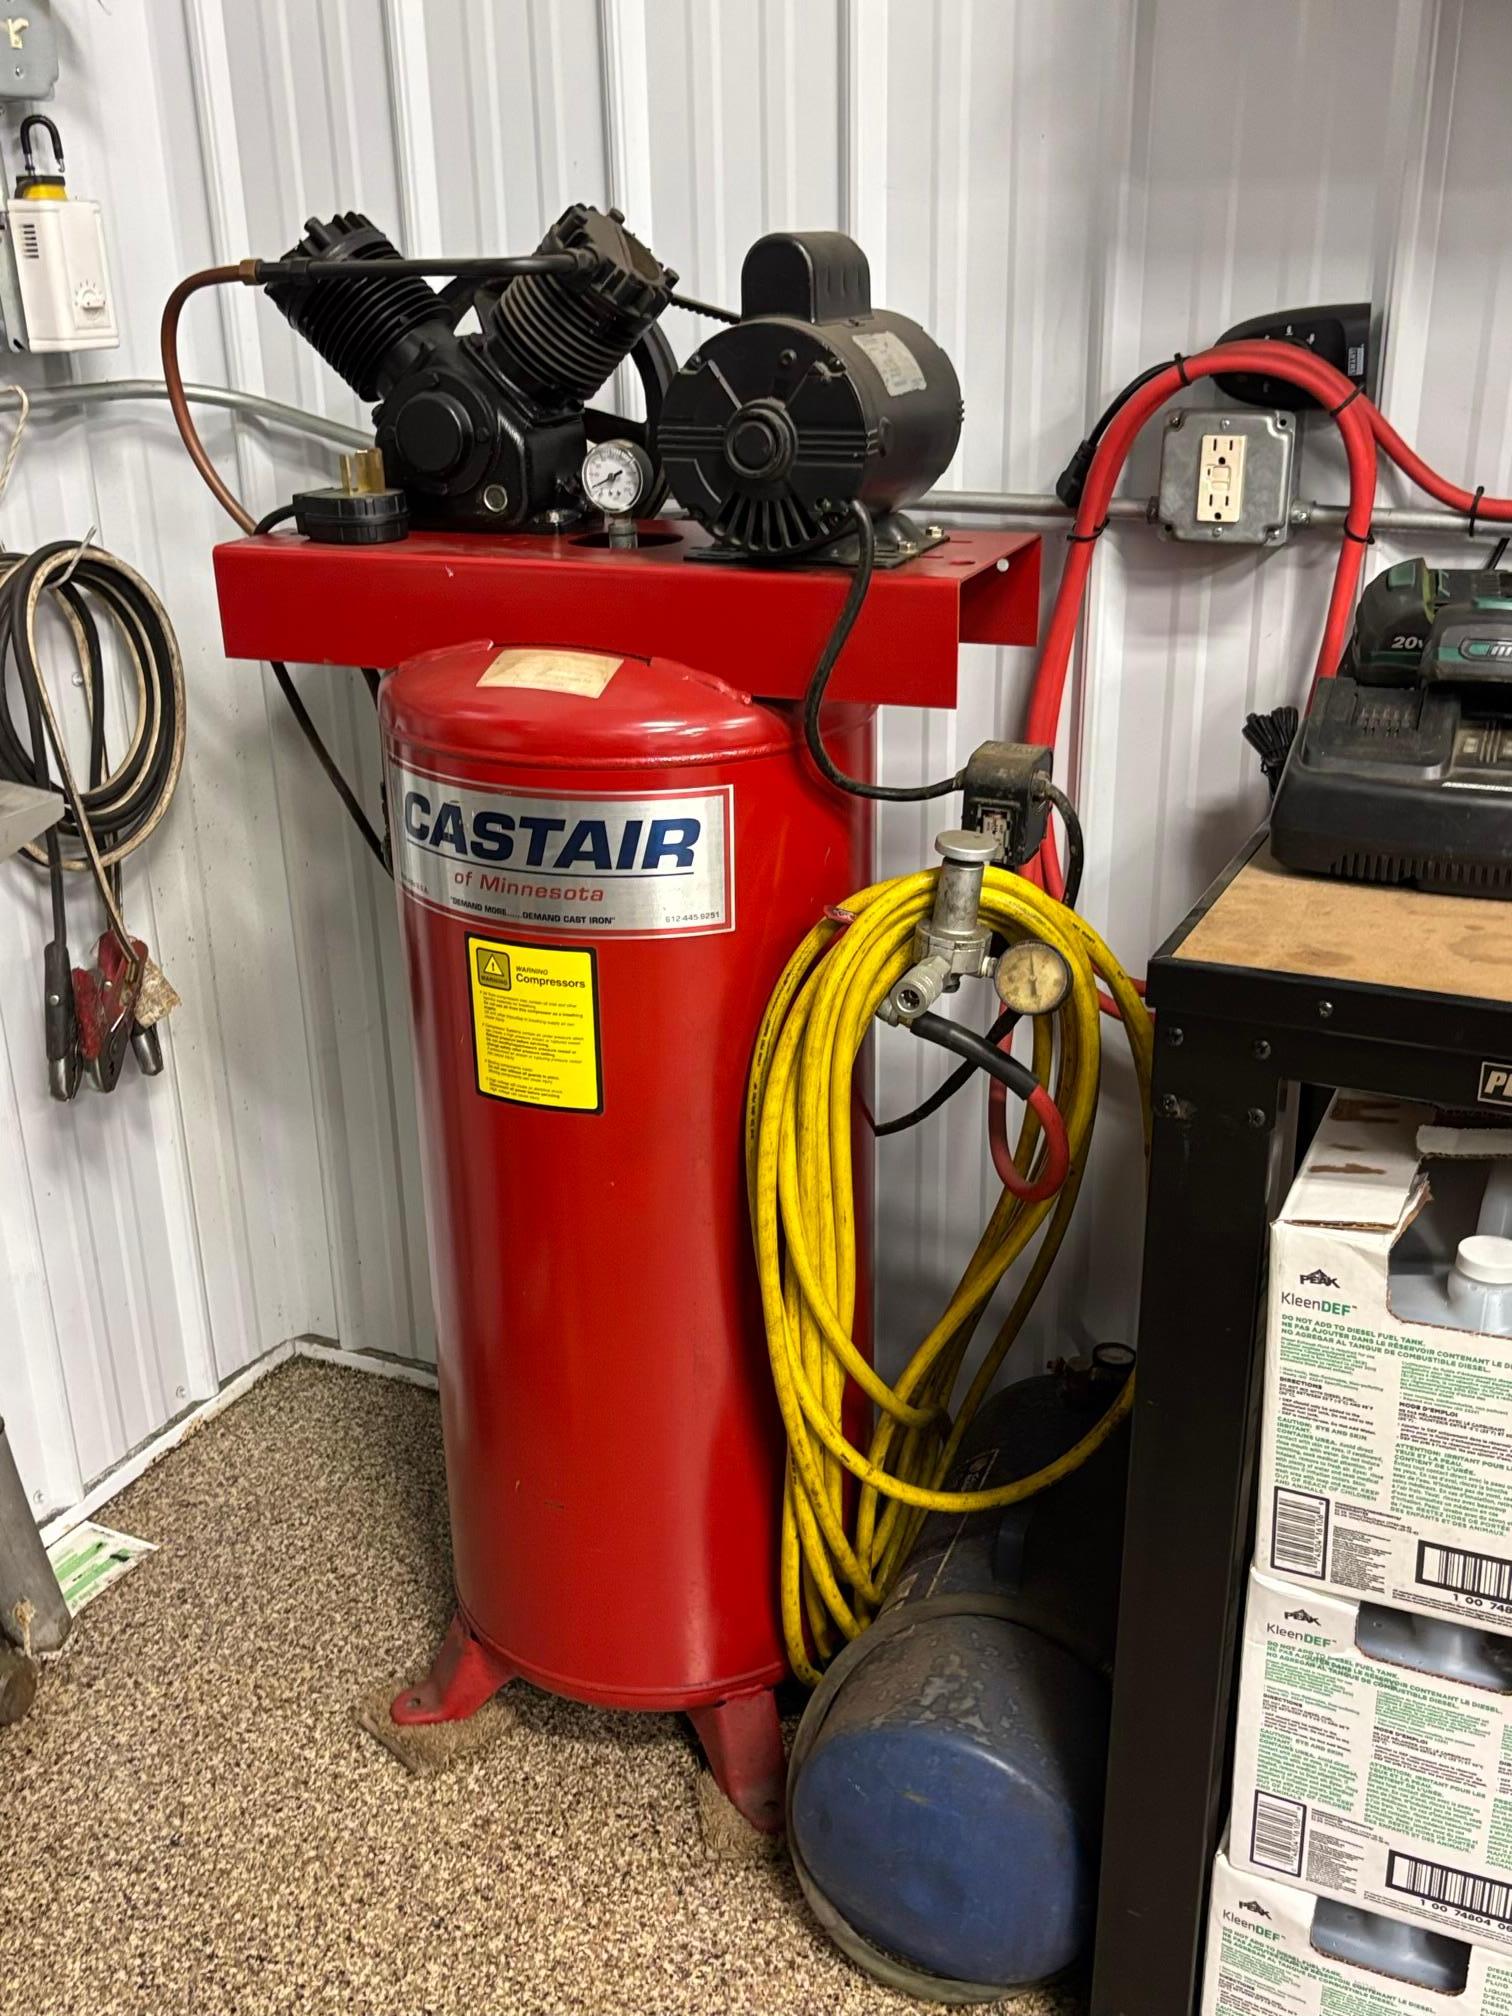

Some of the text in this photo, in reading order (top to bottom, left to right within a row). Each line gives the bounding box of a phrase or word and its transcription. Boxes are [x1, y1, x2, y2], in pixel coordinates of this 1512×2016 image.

[405, 791, 701, 870] CASTAIR
[455, 871, 604, 901] of Minnesota
[563, 913, 586, 924] CAST
[516, 966, 548, 975] WARNING
[516, 973, 585, 988] Compressors
[1300, 1269, 1340, 1289] PEAK
[1296, 1316, 1312, 1324] NOT
[1347, 1326, 1375, 1337] DIESEL
[1378, 1333, 1398, 1342] FUEL
[1401, 1337, 1425, 1346] TANK.
[1453, 1593, 1459, 1602] 1
[1465, 1596, 1483, 1607] 00
[1284, 1609, 1321, 1627] PEAK
[1432, 1903, 1448, 1912] 00
[1454, 1909, 1492, 1926] 74804
